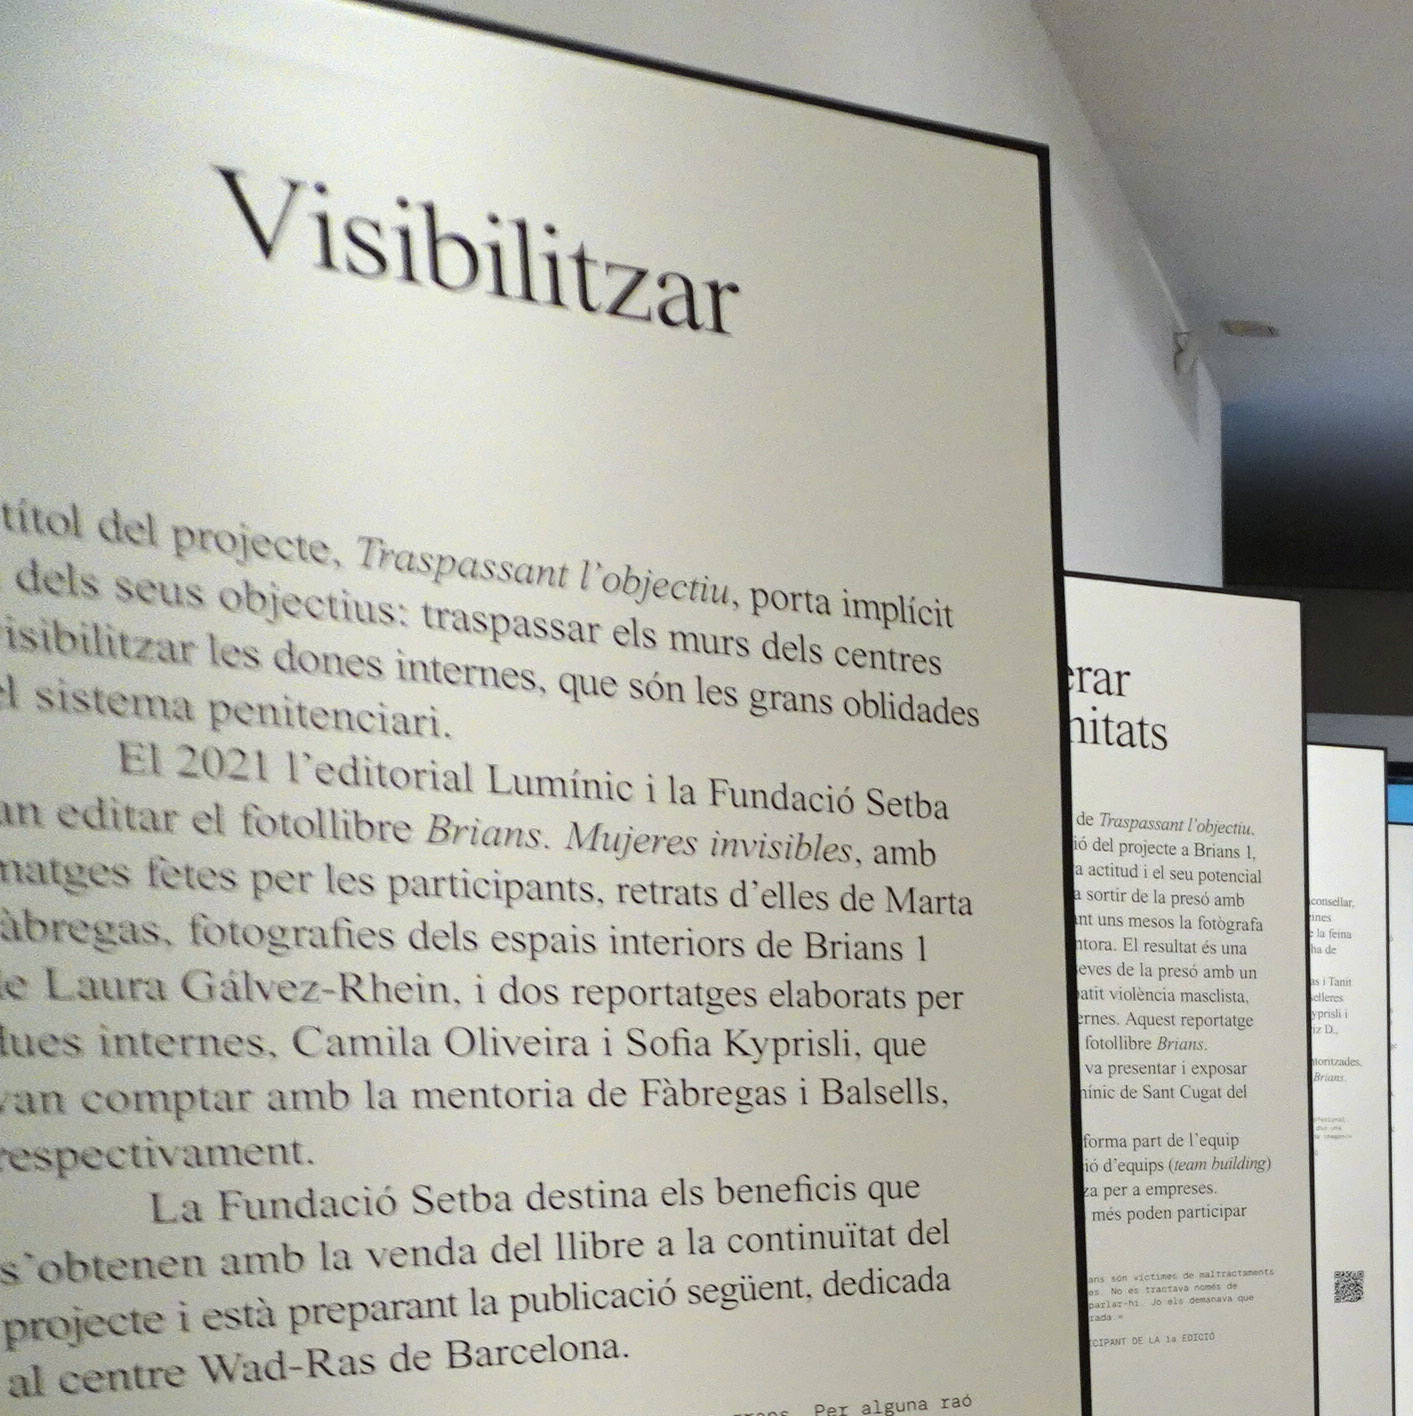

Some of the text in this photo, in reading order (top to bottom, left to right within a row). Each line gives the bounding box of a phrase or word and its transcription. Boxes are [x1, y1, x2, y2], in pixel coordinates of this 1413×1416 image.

[211, 165, 740, 336] Visibilitzar
[1, 497, 83, 539] títol
[97, 507, 158, 547] del
[172, 523, 341, 568] projecte,
[357, 536, 569, 589] Traspassant
[749, 587, 832, 617] porta
[842, 588, 954, 630] implícit
[118, 740, 160, 776] El
[178, 744, 267, 782] 2021
[487, 763, 633, 802] Lumínic
[646, 773, 656, 803] i
[668, 774, 696, 806] la
[709, 777, 855, 815] Fundació
[866, 787, 949, 820] Setba
[1076, 810, 1094, 826] de
[1099, 812, 1184, 833] Traspassant
[1316, 927, 1352, 939] la feina
[1085, 1034, 1207, 1051] fotollibre Brians.
[1091, 1203, 1247, 1224] més poden participar
[1131, 1331, 1215, 1345] DE LA 1a EDICIÓ
[861, 1399, 928, 1416] alguna
[940, 1393, 972, 1409] raó
